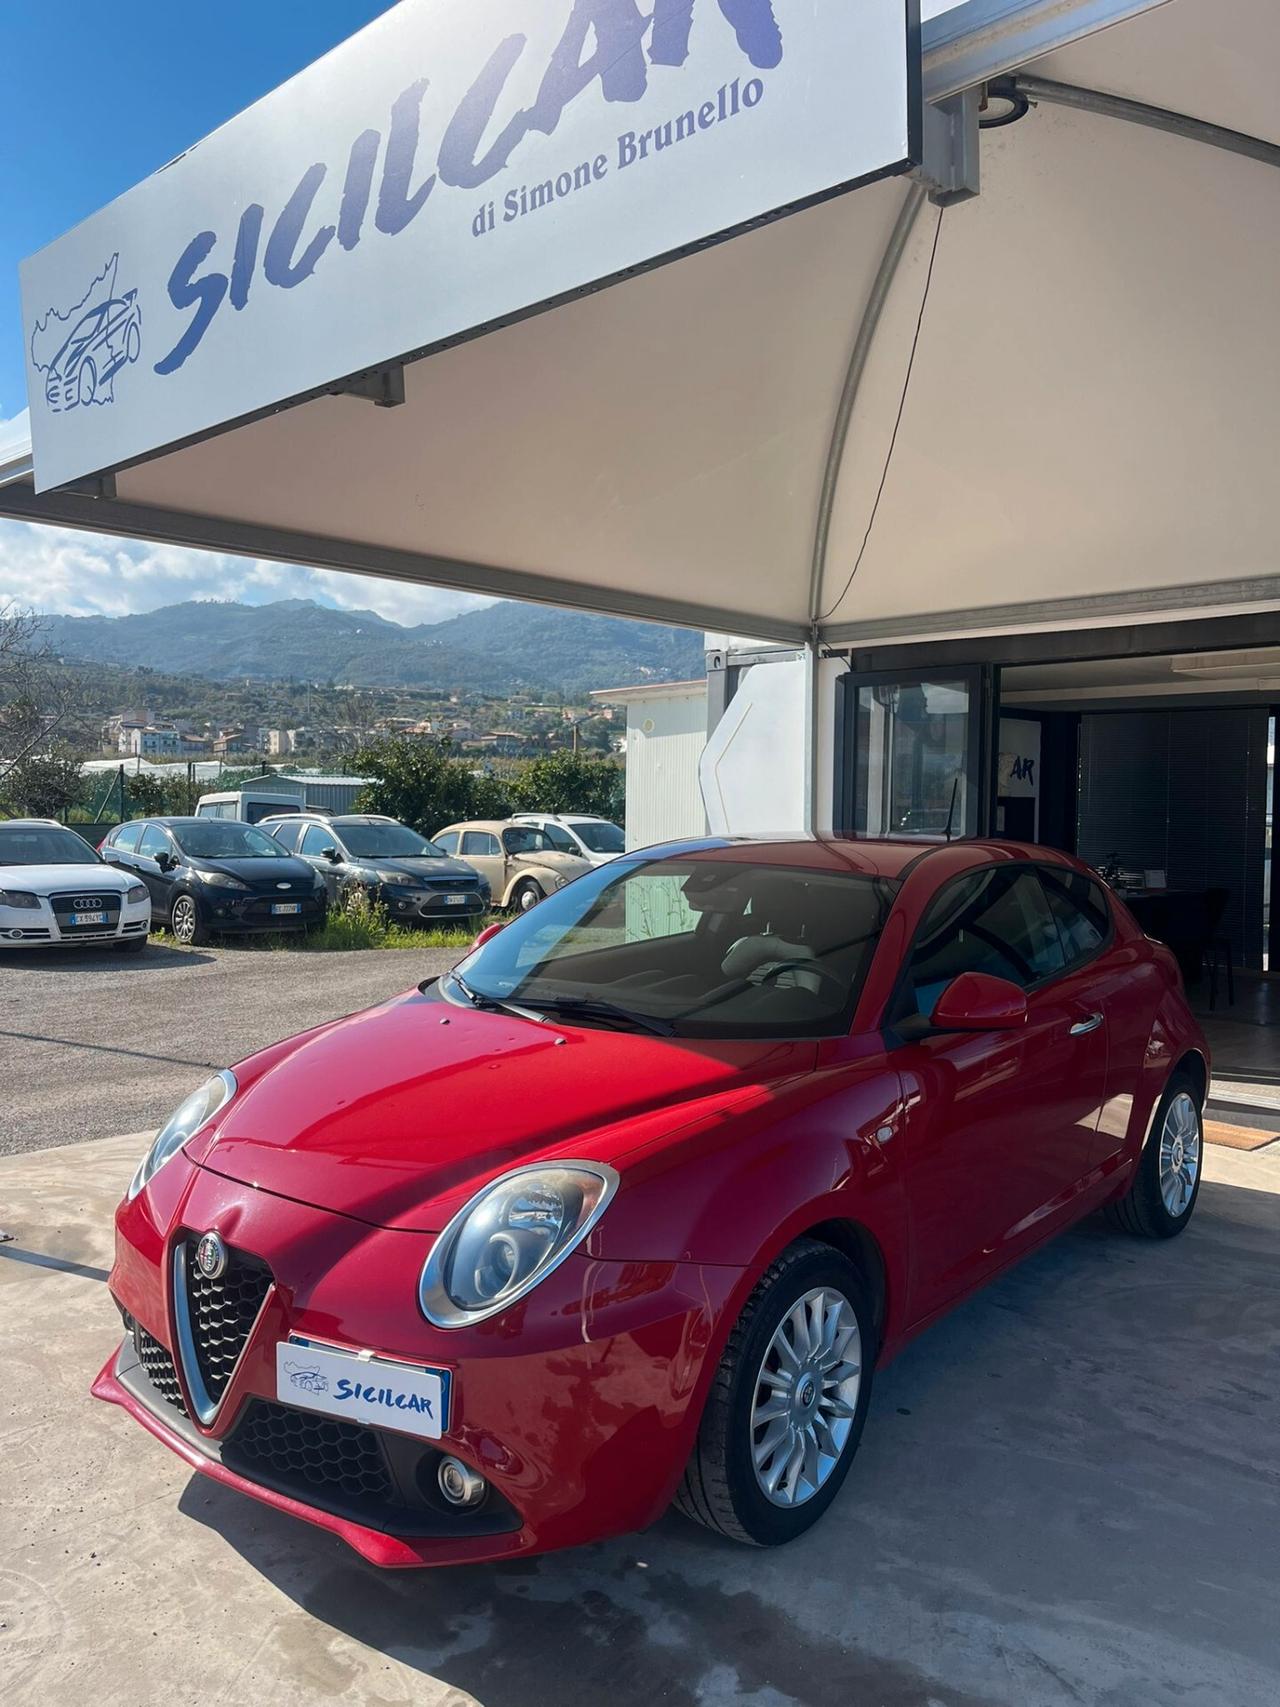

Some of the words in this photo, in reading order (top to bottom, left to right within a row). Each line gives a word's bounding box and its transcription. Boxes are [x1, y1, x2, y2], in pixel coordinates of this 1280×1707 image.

[471, 207, 496, 238] di
[502, 154, 608, 224] Simone
[617, 77, 764, 170] Brunello
[333, 1378, 434, 1420] SICILCAR
